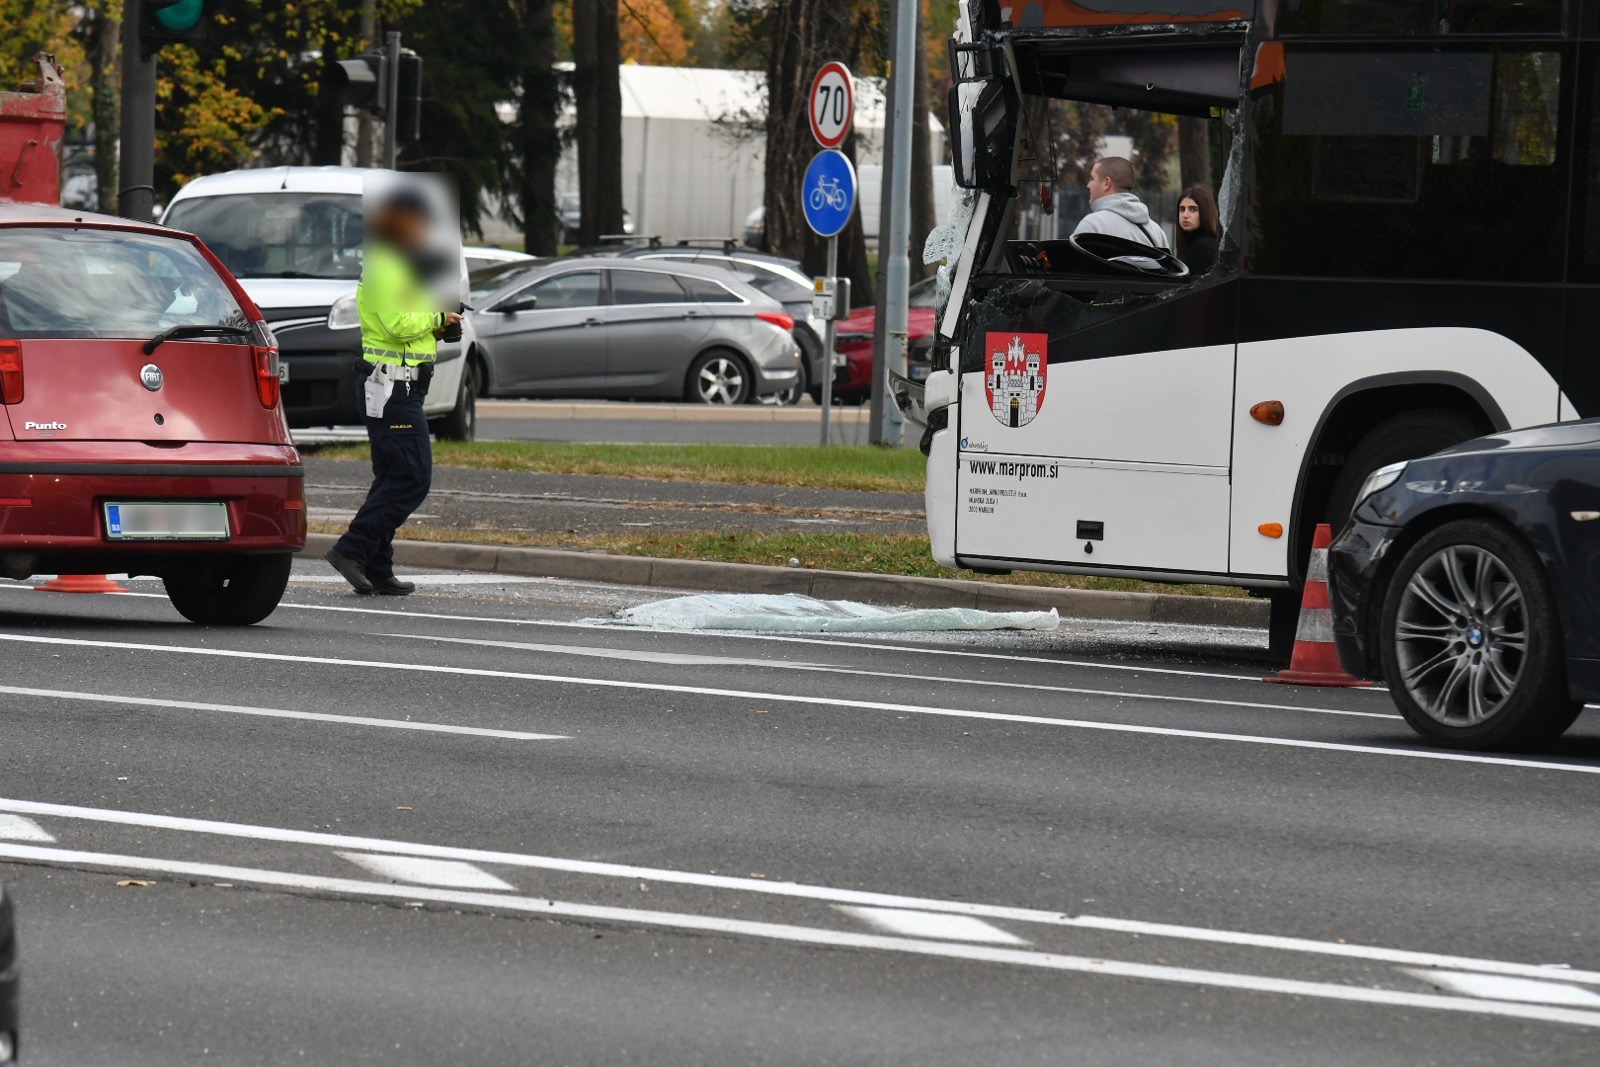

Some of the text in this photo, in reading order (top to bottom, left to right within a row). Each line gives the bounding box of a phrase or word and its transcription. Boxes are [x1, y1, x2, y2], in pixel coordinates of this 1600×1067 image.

[819, 85, 844, 125] 70
[145, 372, 160, 382] FIAT
[25, 421, 67, 430] Punto
[969, 461, 1059, 481] www.marprom.si
